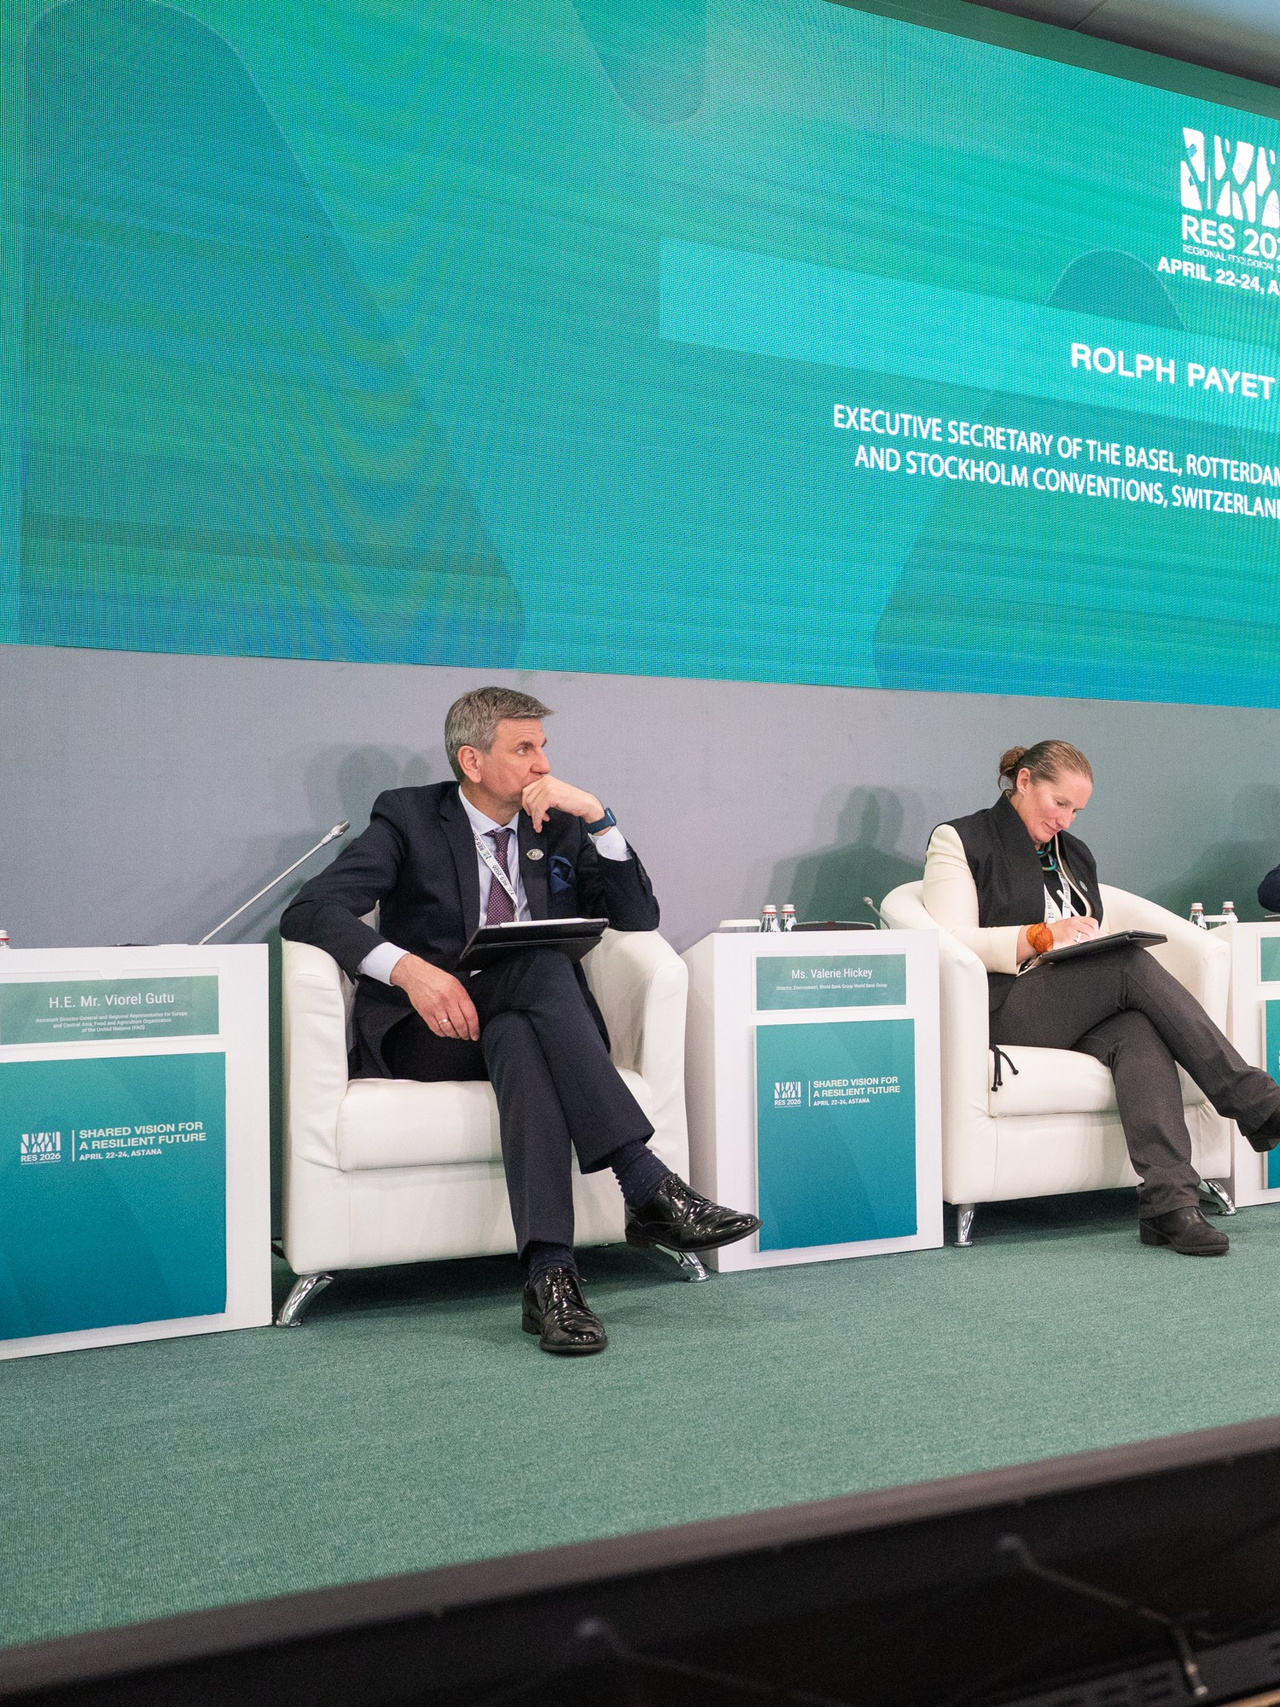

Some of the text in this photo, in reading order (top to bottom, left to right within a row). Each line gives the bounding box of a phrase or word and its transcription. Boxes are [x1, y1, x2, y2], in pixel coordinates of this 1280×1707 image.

[1182, 214, 1235, 250] RES
[1183, 244, 1226, 261] REGIONAL
[1157, 257, 1211, 282] APRIL
[1215, 268, 1265, 295] 22-24,
[1071, 343, 1275, 400] ROLPH PAYET
[833, 404, 942, 443] EXECUTIVE
[948, 420, 1053, 455] SECRETARY
[1058, 436, 1081, 459] OF
[1086, 440, 1121, 465] THE
[1126, 445, 1182, 477] BASEL,
[855, 445, 900, 472] AND
[906, 451, 1027, 488] STOCKHOLM
[1033, 467, 1168, 508] CONVENTIONS,
[791, 967, 873, 979] Ms. Valerie Hickey
[49, 993, 174, 1008] H.E. Mr. Viorel Gutu
[813, 1080, 848, 1088] SHARED
[881, 1076, 898, 1084] FOR
[821, 1088, 865, 1097] RESILIENT
[867, 1086, 900, 1094] FUTURE
[79, 1121, 203, 1138] SHARED VISION FOR
[79, 1132, 206, 1150] A RESILIENT FUTURE
[21, 1153, 61, 1162] RES 2026
[79, 1148, 162, 1161] APRIL 22-24, ASTANA
